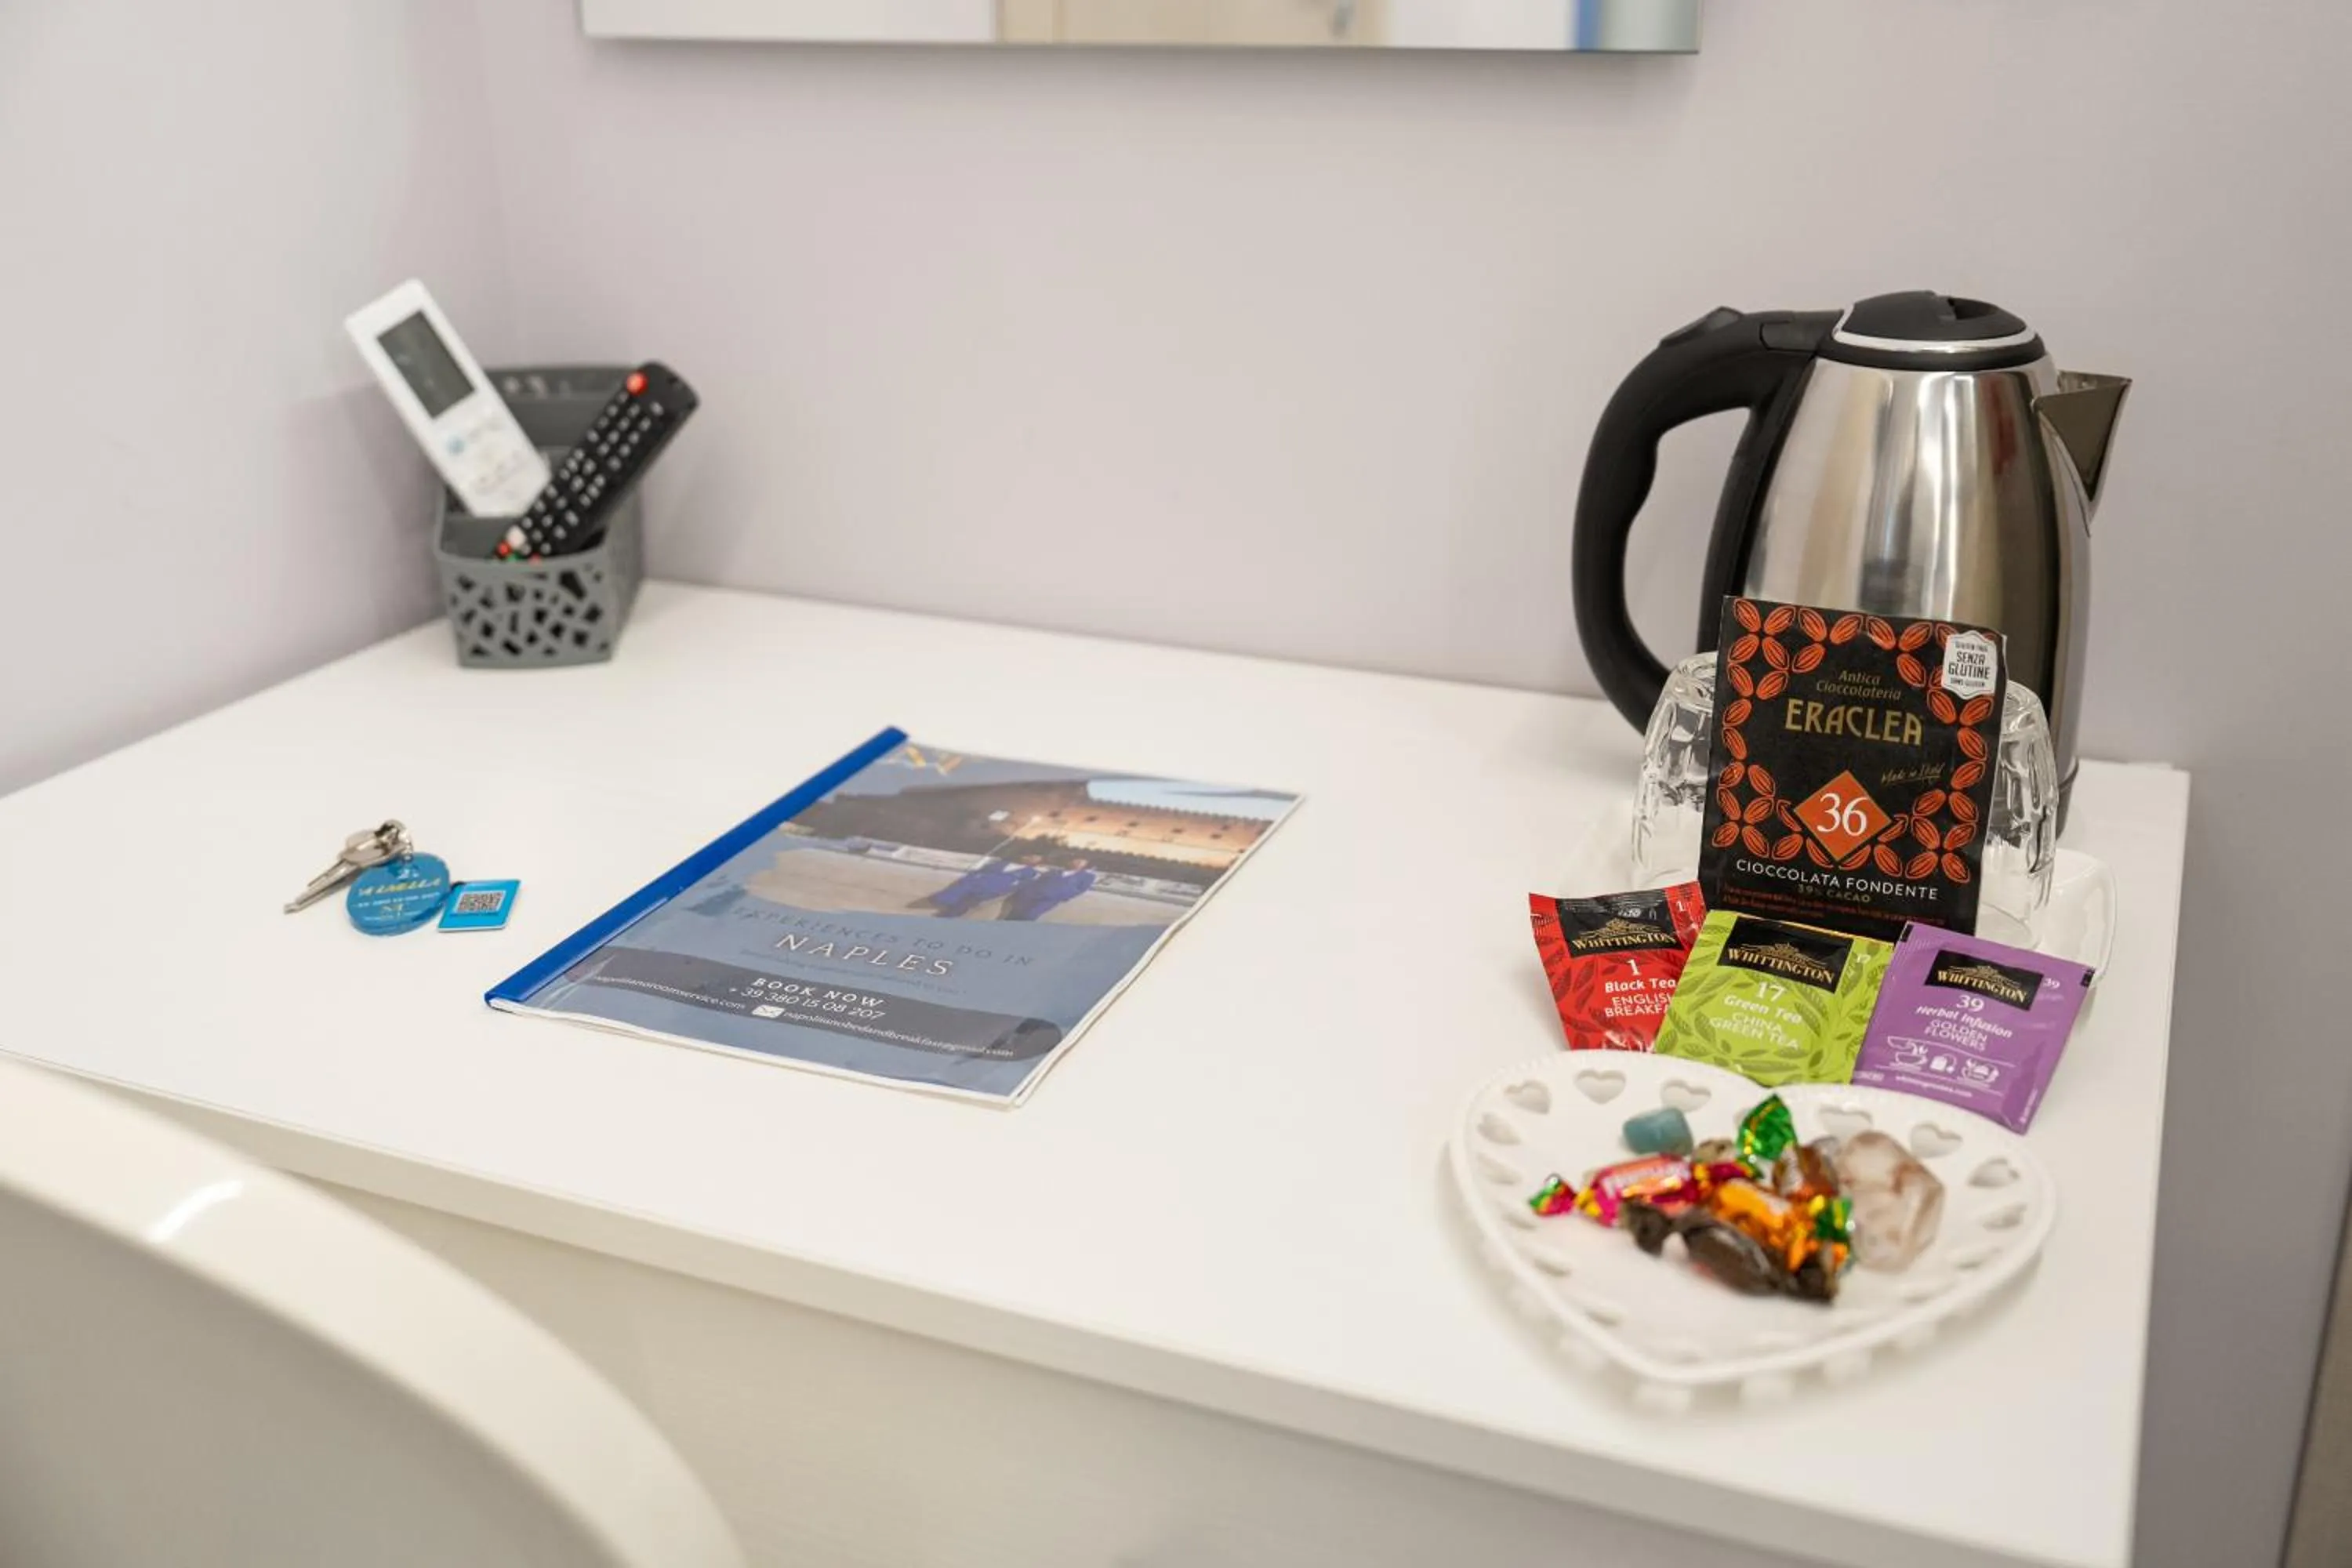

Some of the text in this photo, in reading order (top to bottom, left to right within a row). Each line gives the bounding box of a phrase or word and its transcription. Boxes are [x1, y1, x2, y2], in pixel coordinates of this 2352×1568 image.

[1957, 651, 1986, 665] SENZA
[1838, 670, 1882, 686] Antica
[1948, 662, 1991, 680] GLUTINE
[1816, 680, 1901, 701] Cioccolateria
[1785, 699, 1923, 746] ERACLEA
[1817, 792, 1868, 837] 36
[1737, 858, 1940, 901] CIOCCOLATA FONDENTE
[1676, 900, 1686, 913] 1
[1827, 887, 1871, 903] CACAO
[914, 938, 944, 950] TO
[956, 944, 993, 960] DO
[1003, 954, 1034, 967] IN
[1572, 932, 1677, 950] WHITTINGTON
[775, 933, 954, 976] NAPLES
[1627, 958, 1641, 976] 1
[1727, 947, 1835, 985] WHITTINGTON
[750, 977, 884, 1007] BOOK NOW
[1605, 978, 1676, 993] Black Tea
[1756, 981, 1788, 1003] 17
[1936, 969, 2027, 1004] WHITTINGTON
[2042, 977, 2061, 989] 39
[740, 986, 764, 999] 39
[764, 991, 800, 1004] 380
[801, 997, 822, 1008] 15
[822, 1000, 848, 1014] 08
[848, 1007, 887, 1019] 207
[1724, 994, 1803, 1025] Green Tea
[1956, 994, 1985, 1012] 39
[1710, 1016, 1799, 1051] GREEN TEA
[1731, 1011, 1783, 1033] CHINA
[1915, 1004, 2013, 1039] Herbal Infusion
[1929, 1018, 1988, 1043] GOLDEN
[1923, 1025, 1987, 1052] FLOWERS
